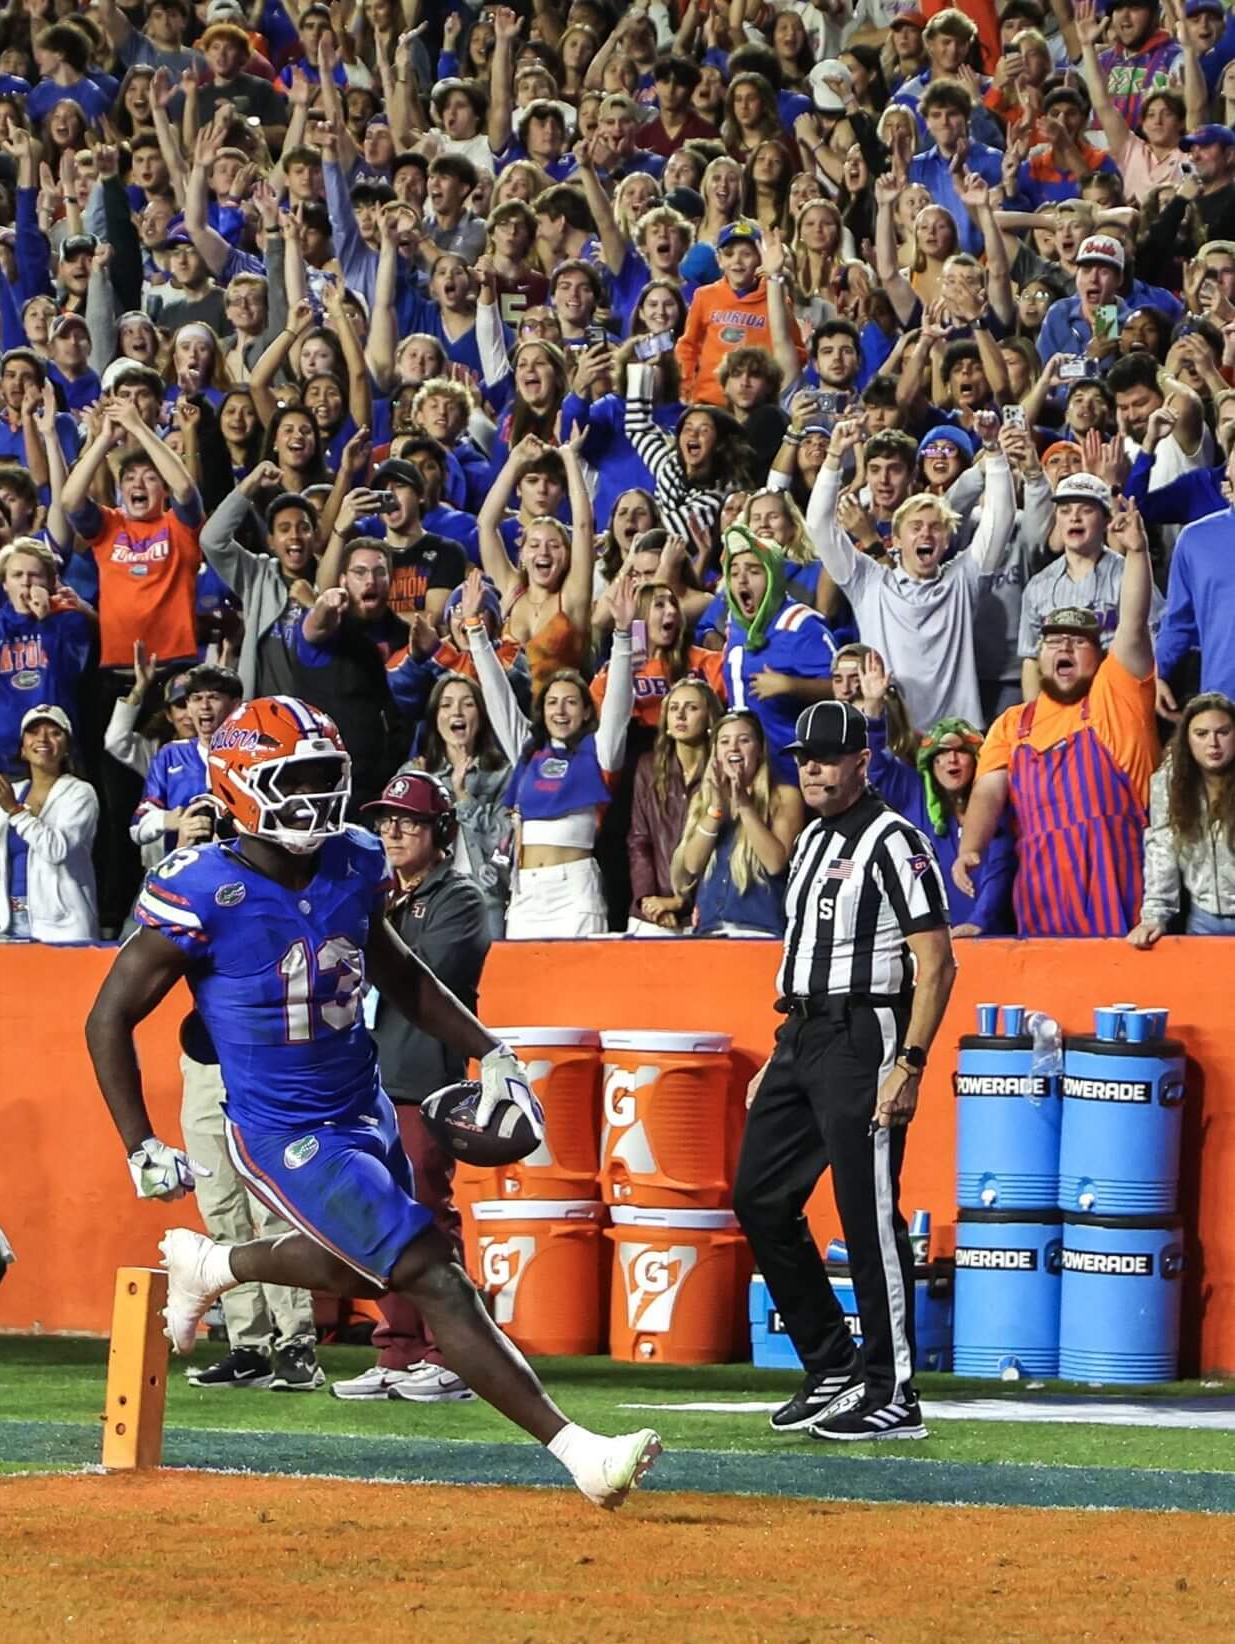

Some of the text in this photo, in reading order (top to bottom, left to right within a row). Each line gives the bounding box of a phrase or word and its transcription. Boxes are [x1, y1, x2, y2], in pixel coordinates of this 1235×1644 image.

[819, 898, 834, 920] S
[277, 936, 365, 1043] 13
[604, 1069, 636, 1127] G
[483, 1243, 510, 1284] G
[633, 1250, 669, 1292] G
